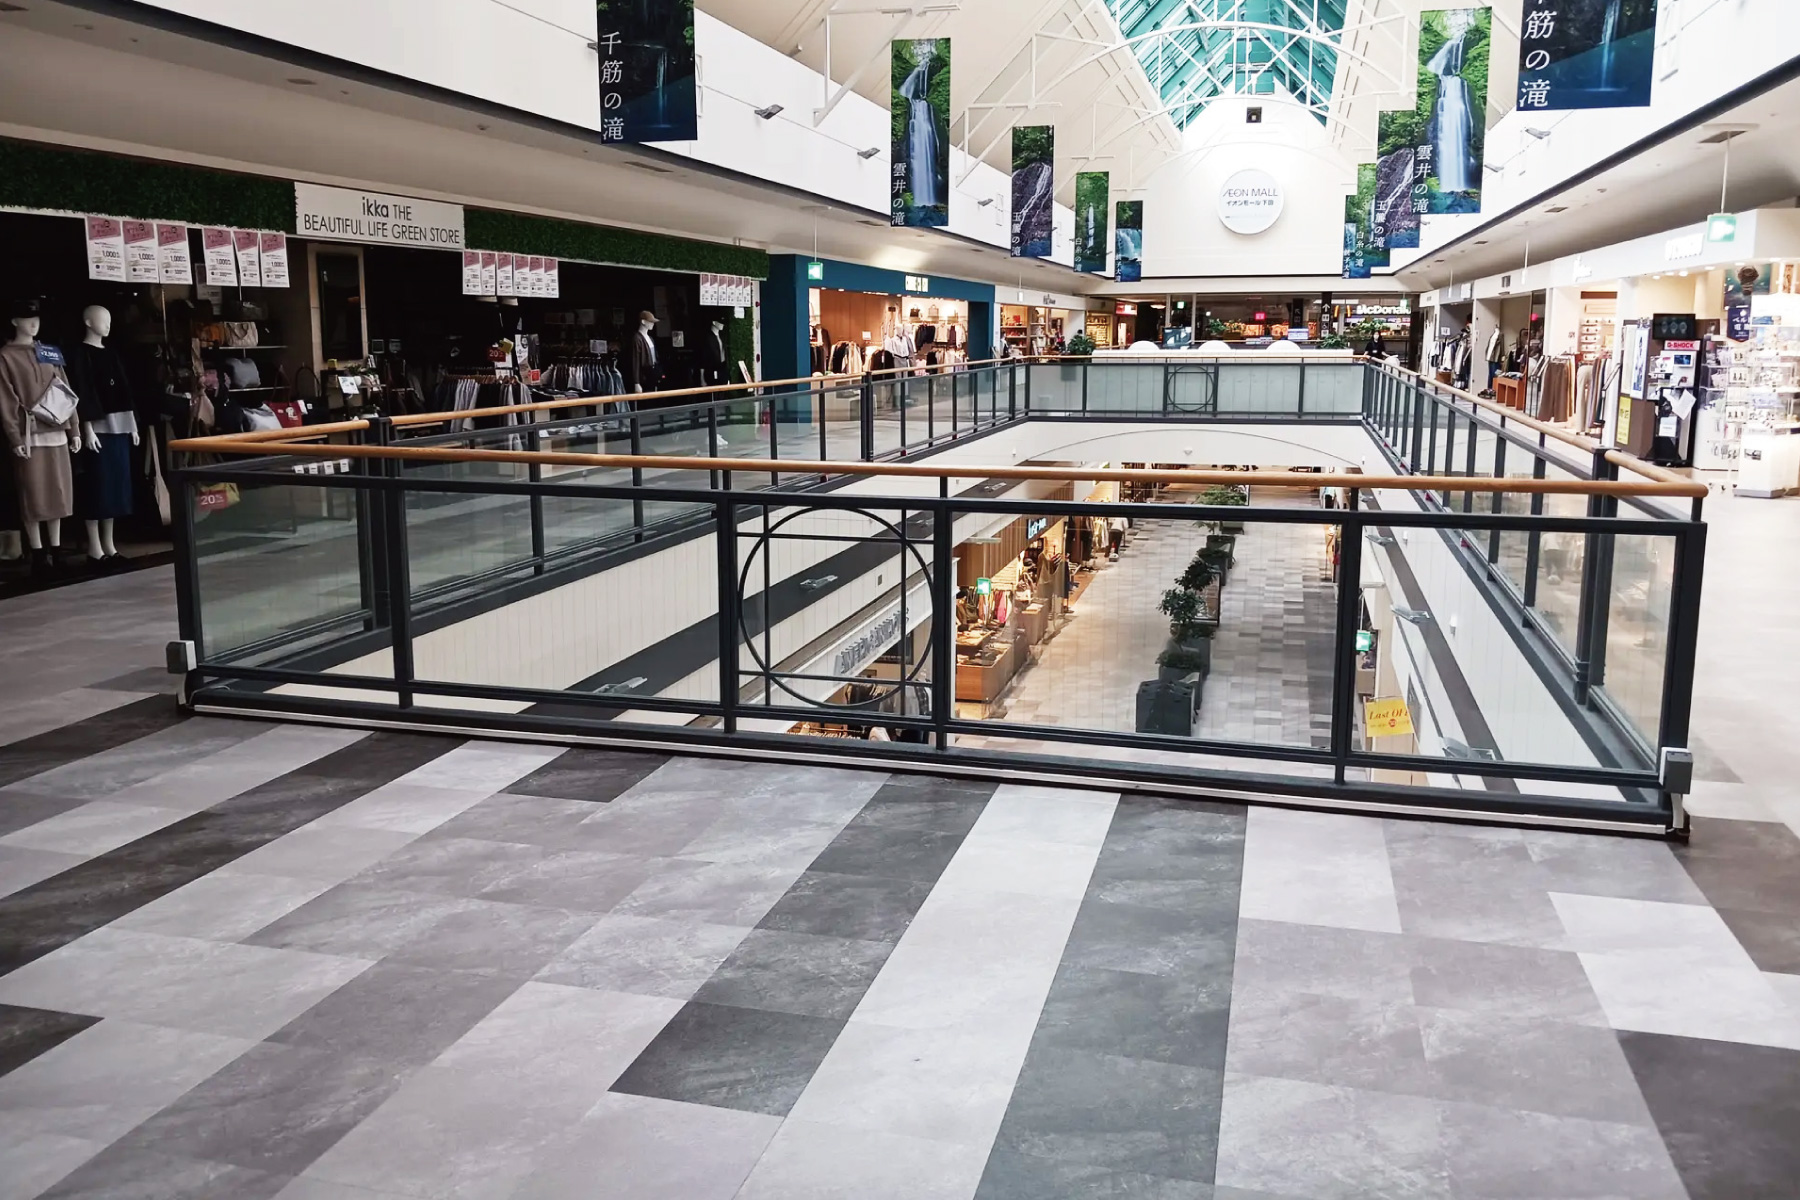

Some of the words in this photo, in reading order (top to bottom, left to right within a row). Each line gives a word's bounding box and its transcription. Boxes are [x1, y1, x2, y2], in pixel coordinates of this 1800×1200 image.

[1519, 0, 1557, 107] 筋の滝
[600, 31, 625, 141] 千筋の滝
[891, 162, 907, 226] 雲井の滝
[1251, 188, 1278, 197] MALL
[1412, 144, 1432, 214] 雲井の滝
[304, 213, 364, 236] BEAUTIFUL
[367, 220, 388, 238] LIFE
[391, 223, 427, 242] GREEN
[429, 227, 460, 244] STORE
[362, 196, 389, 218] ikka
[392, 204, 412, 221] THE
[1369, 711, 1389, 720] Last
